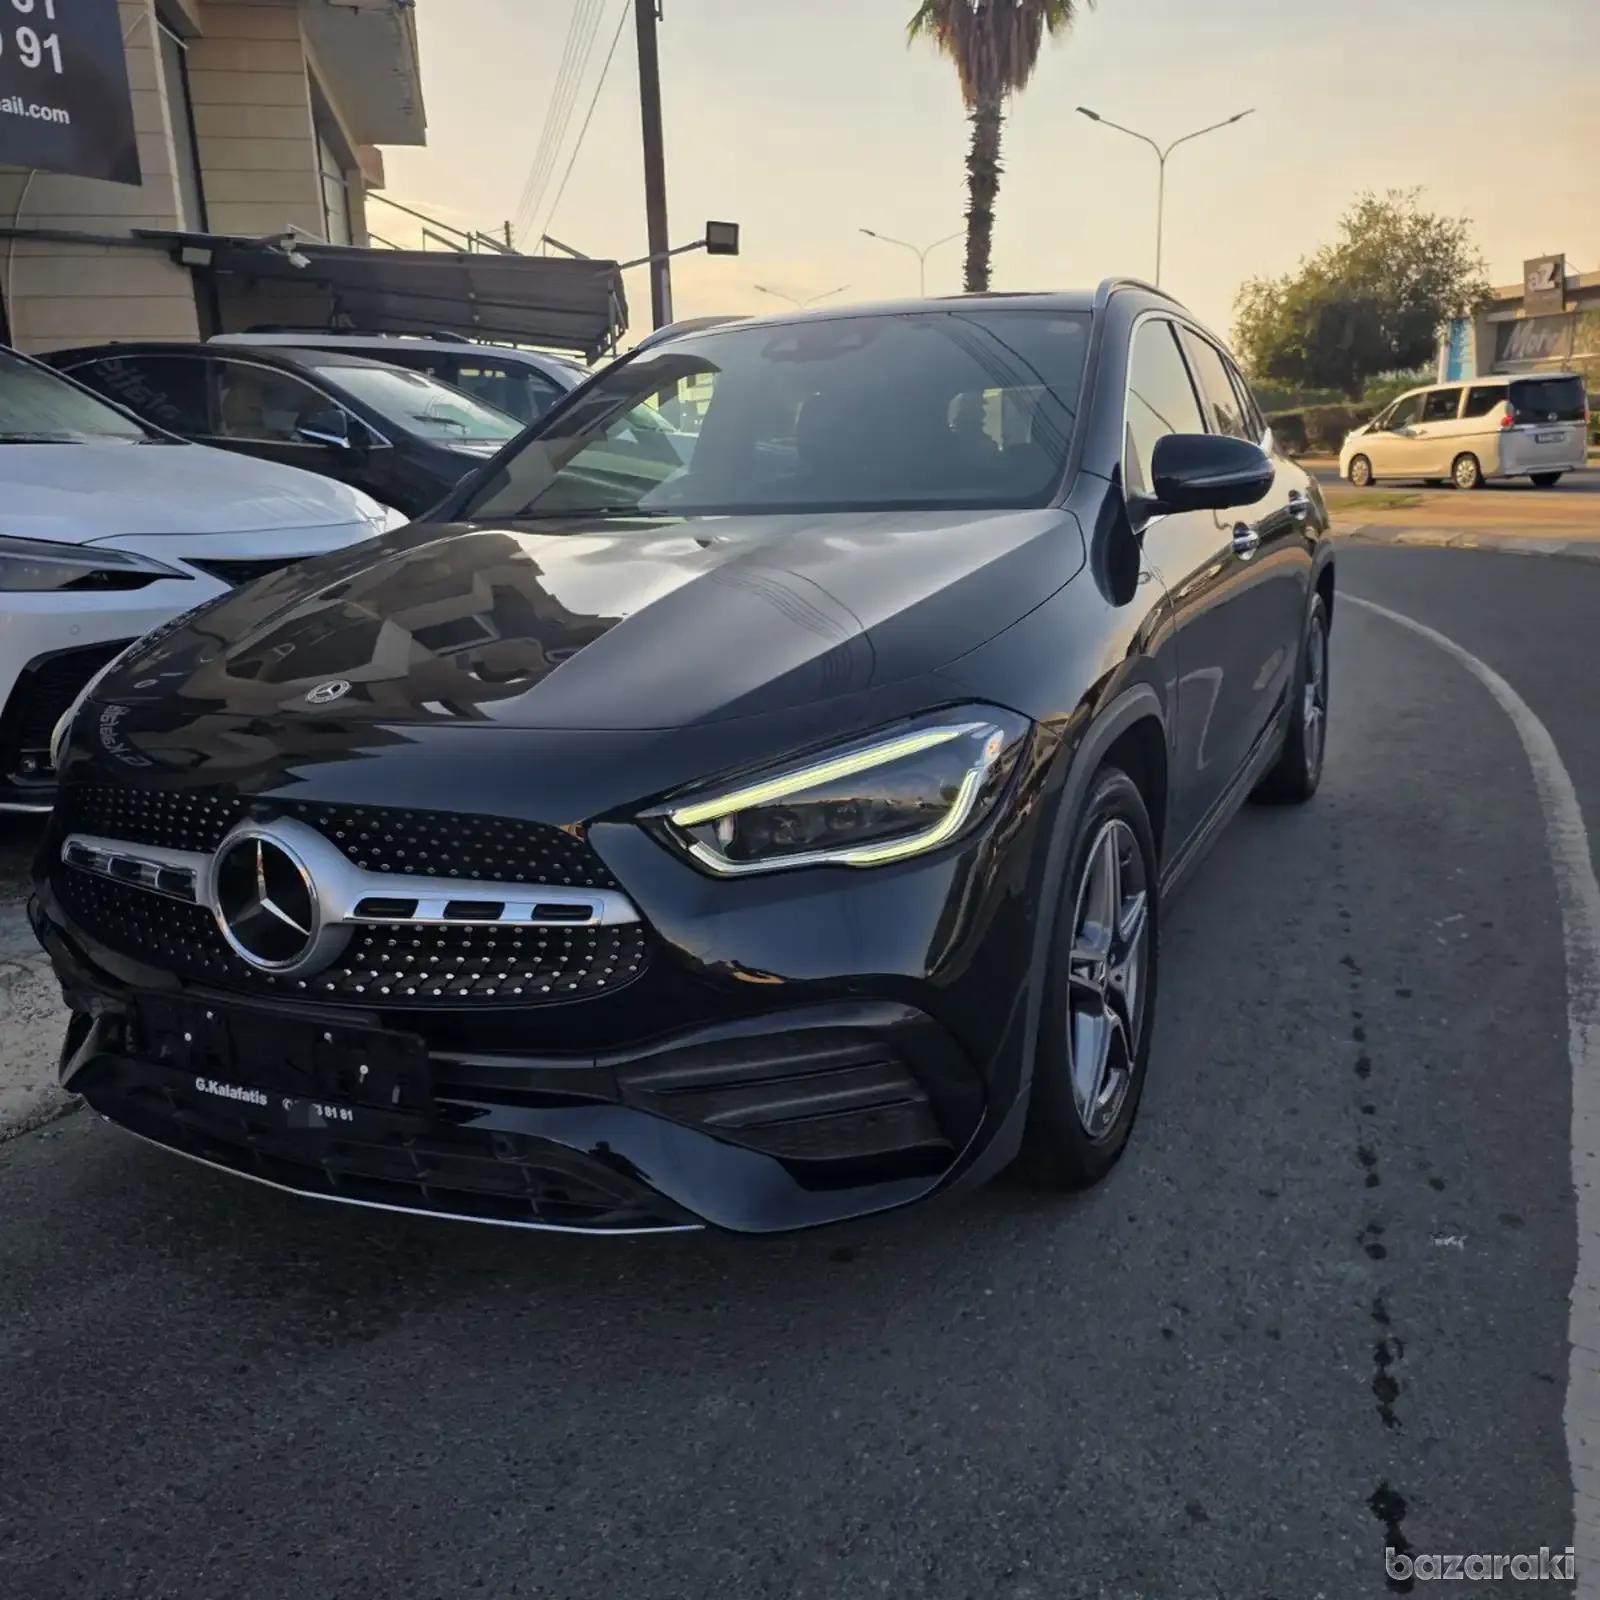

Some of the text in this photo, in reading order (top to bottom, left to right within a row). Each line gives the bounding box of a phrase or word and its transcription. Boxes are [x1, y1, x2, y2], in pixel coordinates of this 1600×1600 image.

[16, 26, 63, 74] 91
[0, 96, 70, 124] ail.com
[195, 1076, 268, 1106] G.Kalafatis
